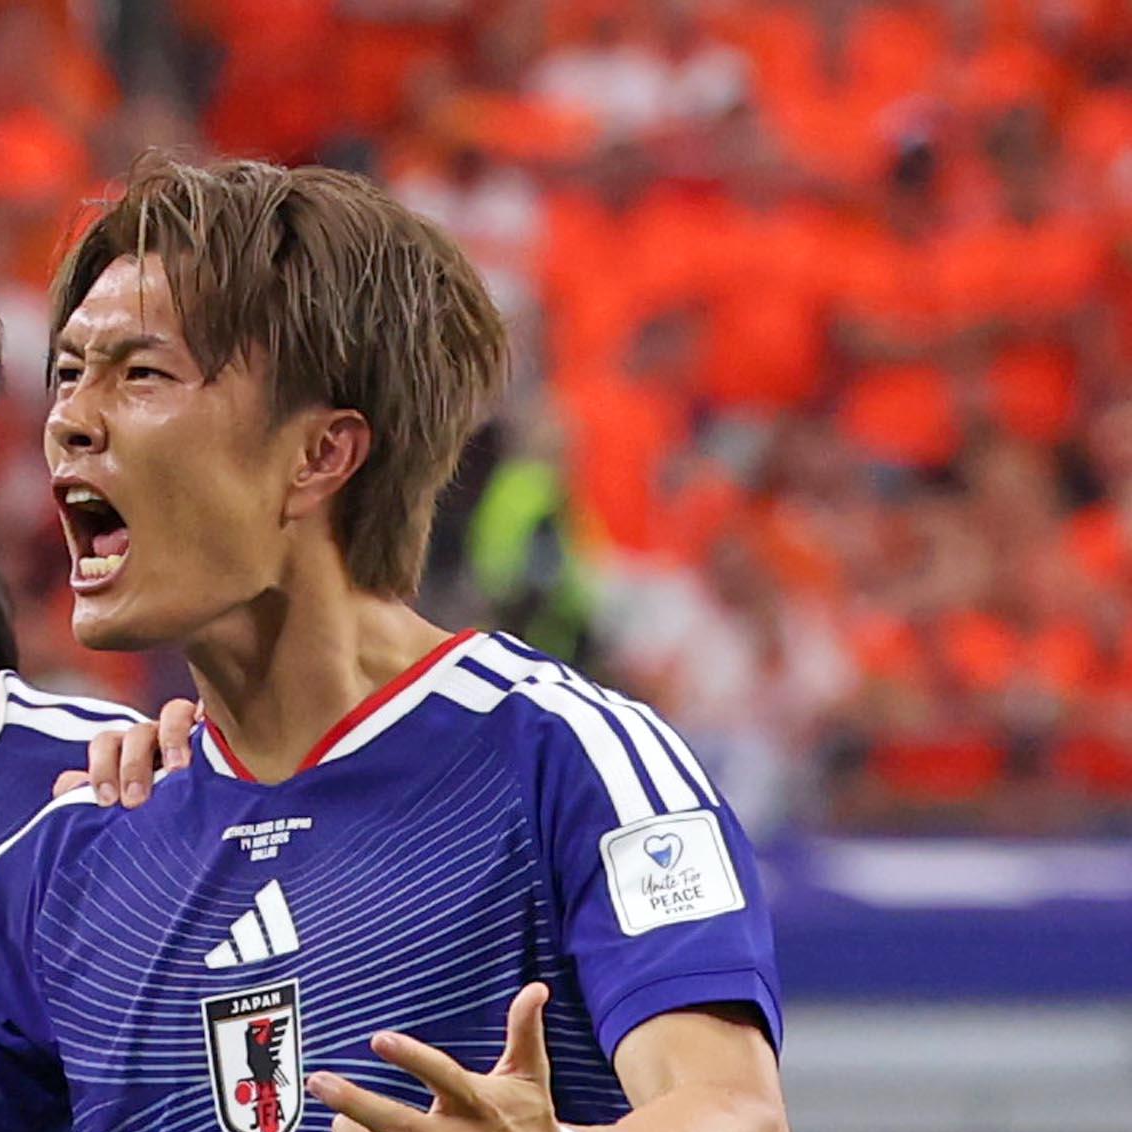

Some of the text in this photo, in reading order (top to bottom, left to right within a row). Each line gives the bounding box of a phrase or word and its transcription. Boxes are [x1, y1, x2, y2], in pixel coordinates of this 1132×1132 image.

[650, 884, 705, 910] PEACE
[230, 991, 281, 1014] JAPAN
[249, 1101, 286, 1130] JFA
